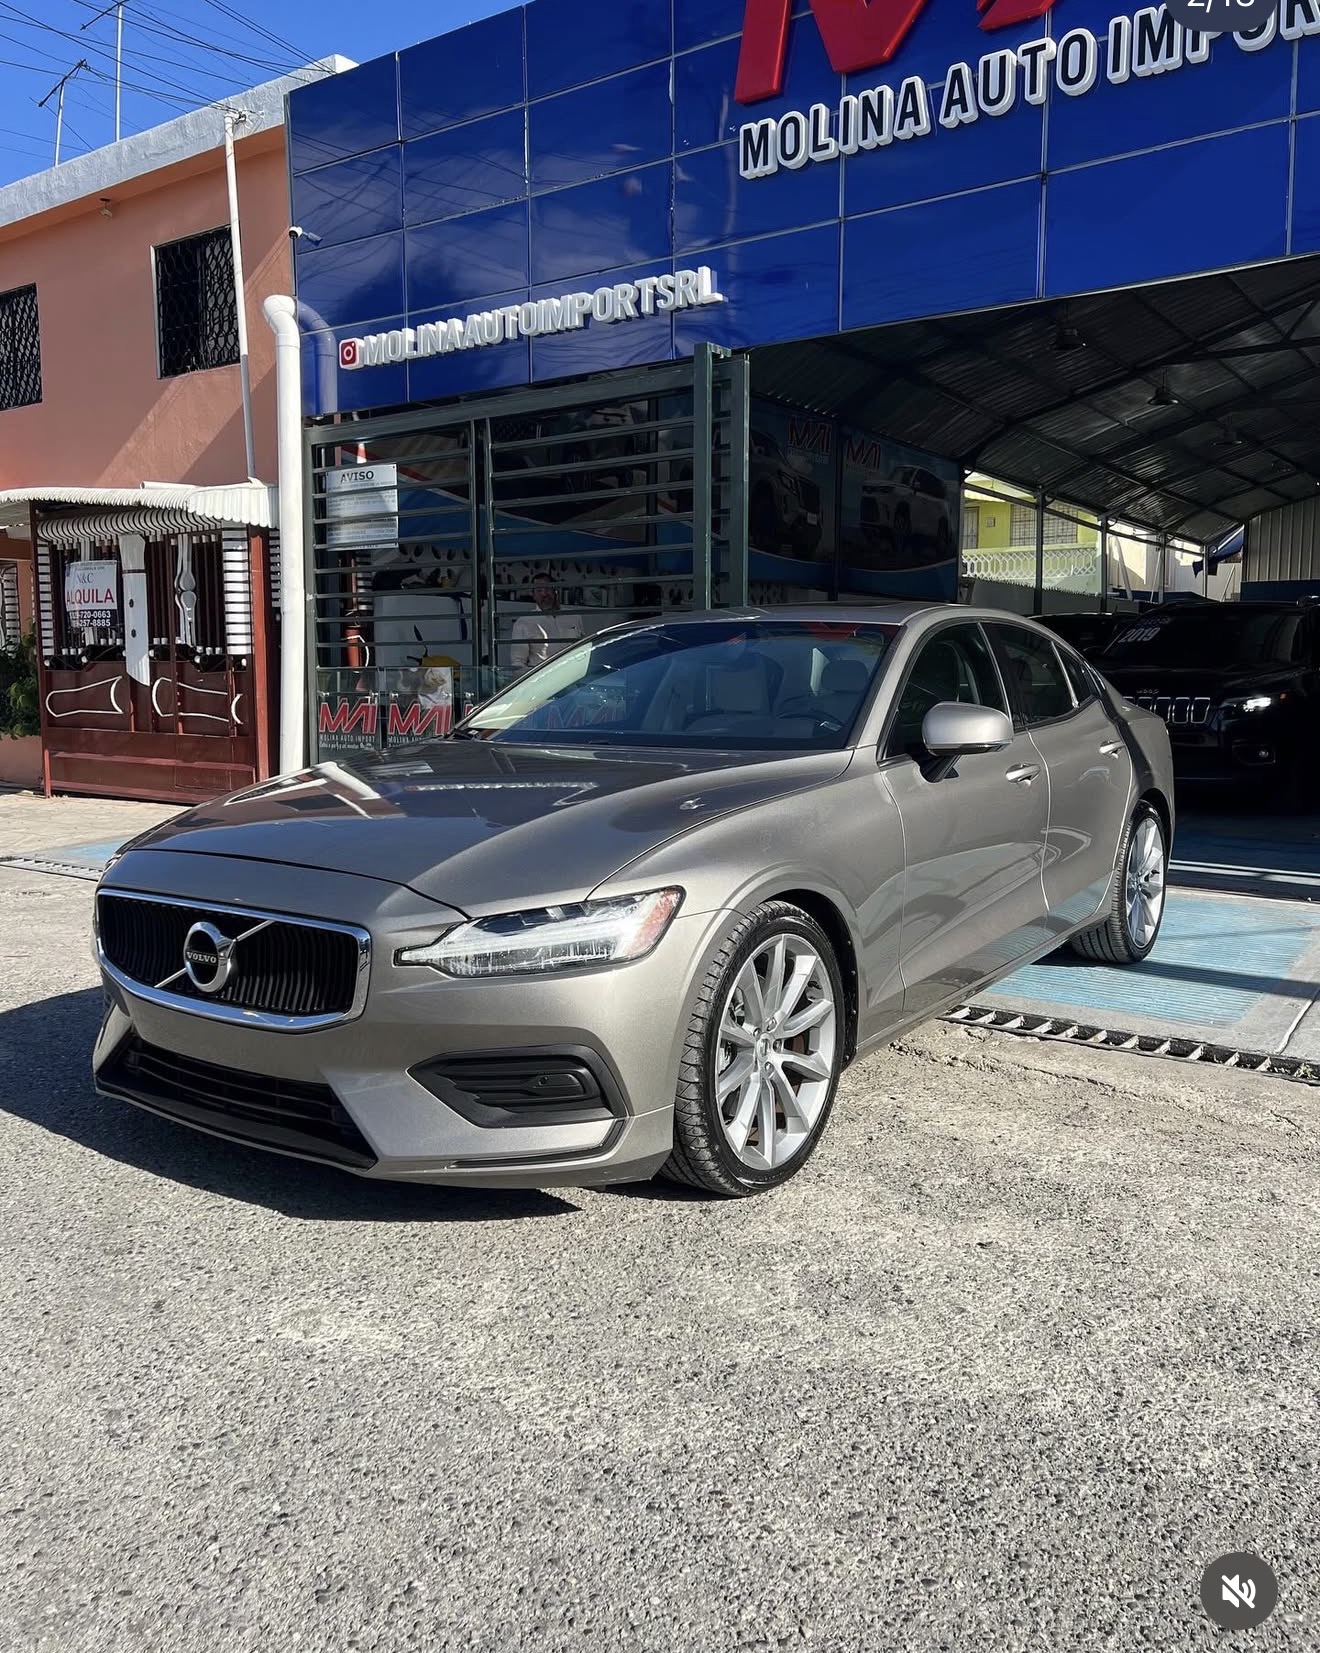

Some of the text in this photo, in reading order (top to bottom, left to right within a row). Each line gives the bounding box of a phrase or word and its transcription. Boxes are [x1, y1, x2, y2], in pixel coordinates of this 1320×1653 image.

[739, 76, 930, 180] MOLINA
[939, 28, 1097, 129] AUTO
[363, 265, 724, 366] MOLINAAUTOIMPORTSRL
[341, 470, 374, 483] AVISO
[66, 588, 115, 604] ALQUILA
[1118, 627, 1161, 643] 2019
[186, 951, 217, 963] VOLVO
